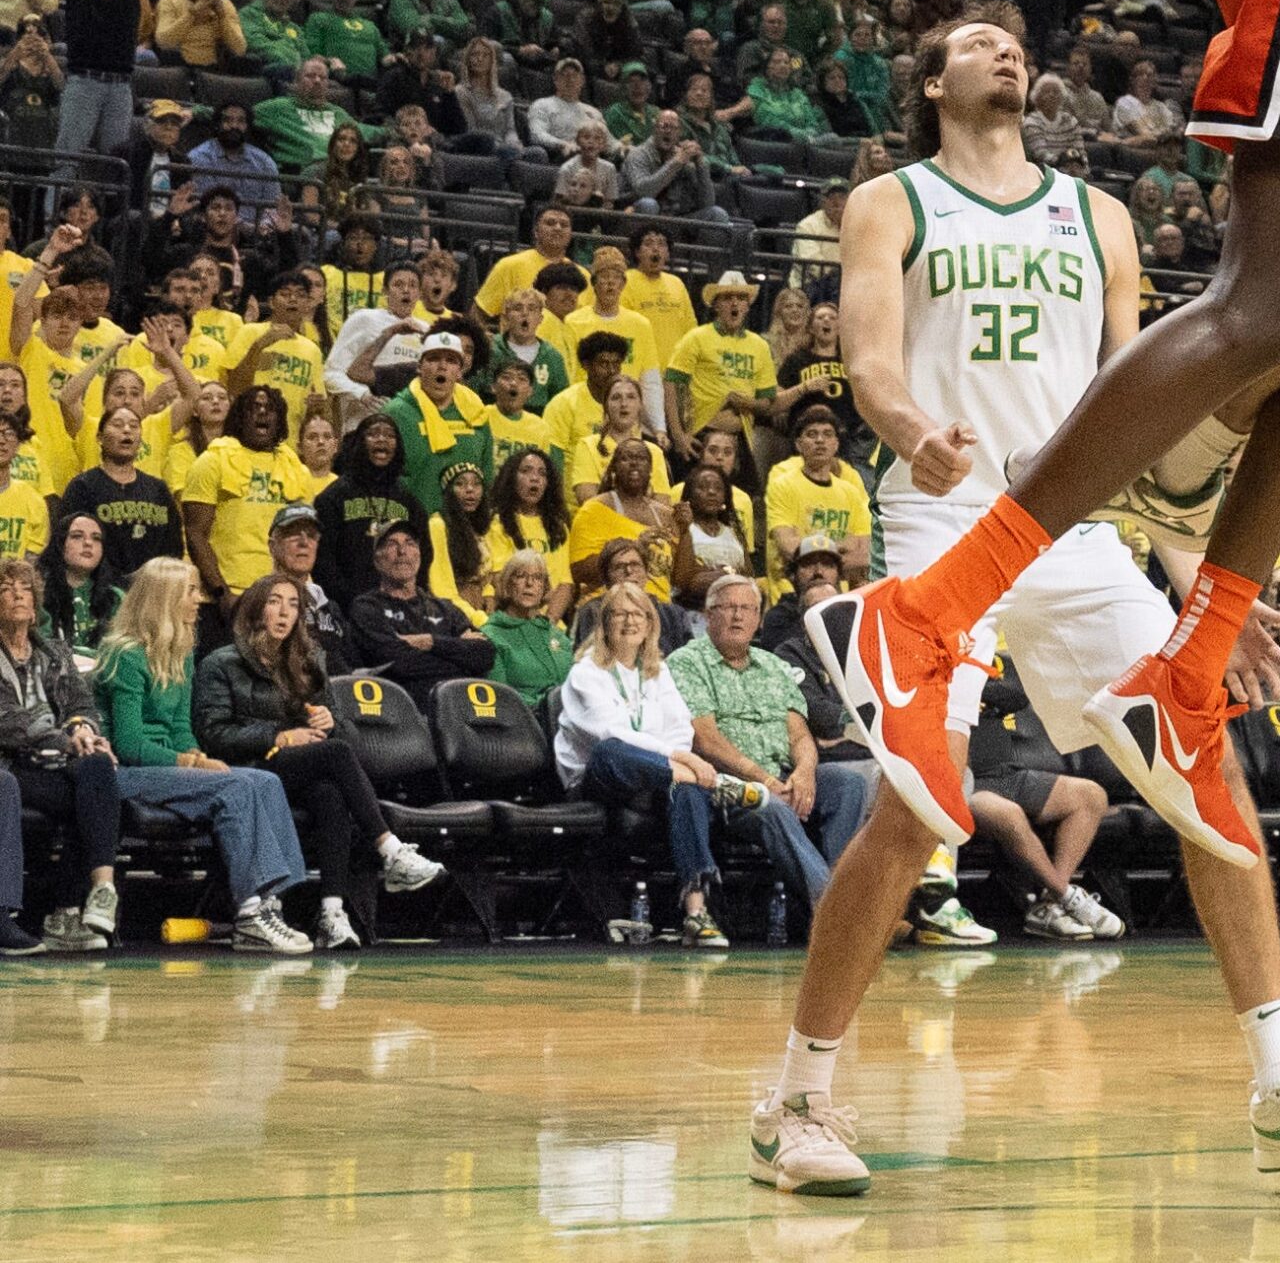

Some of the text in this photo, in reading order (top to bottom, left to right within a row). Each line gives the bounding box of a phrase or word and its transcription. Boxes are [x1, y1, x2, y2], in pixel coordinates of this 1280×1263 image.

[928, 244, 1083, 302] DUCKS
[970, 304, 1039, 361] 32
[0, 517, 25, 540] PIT
[827, 509, 851, 530] PIT
[353, 680, 383, 703] O
[467, 682, 496, 705] O
